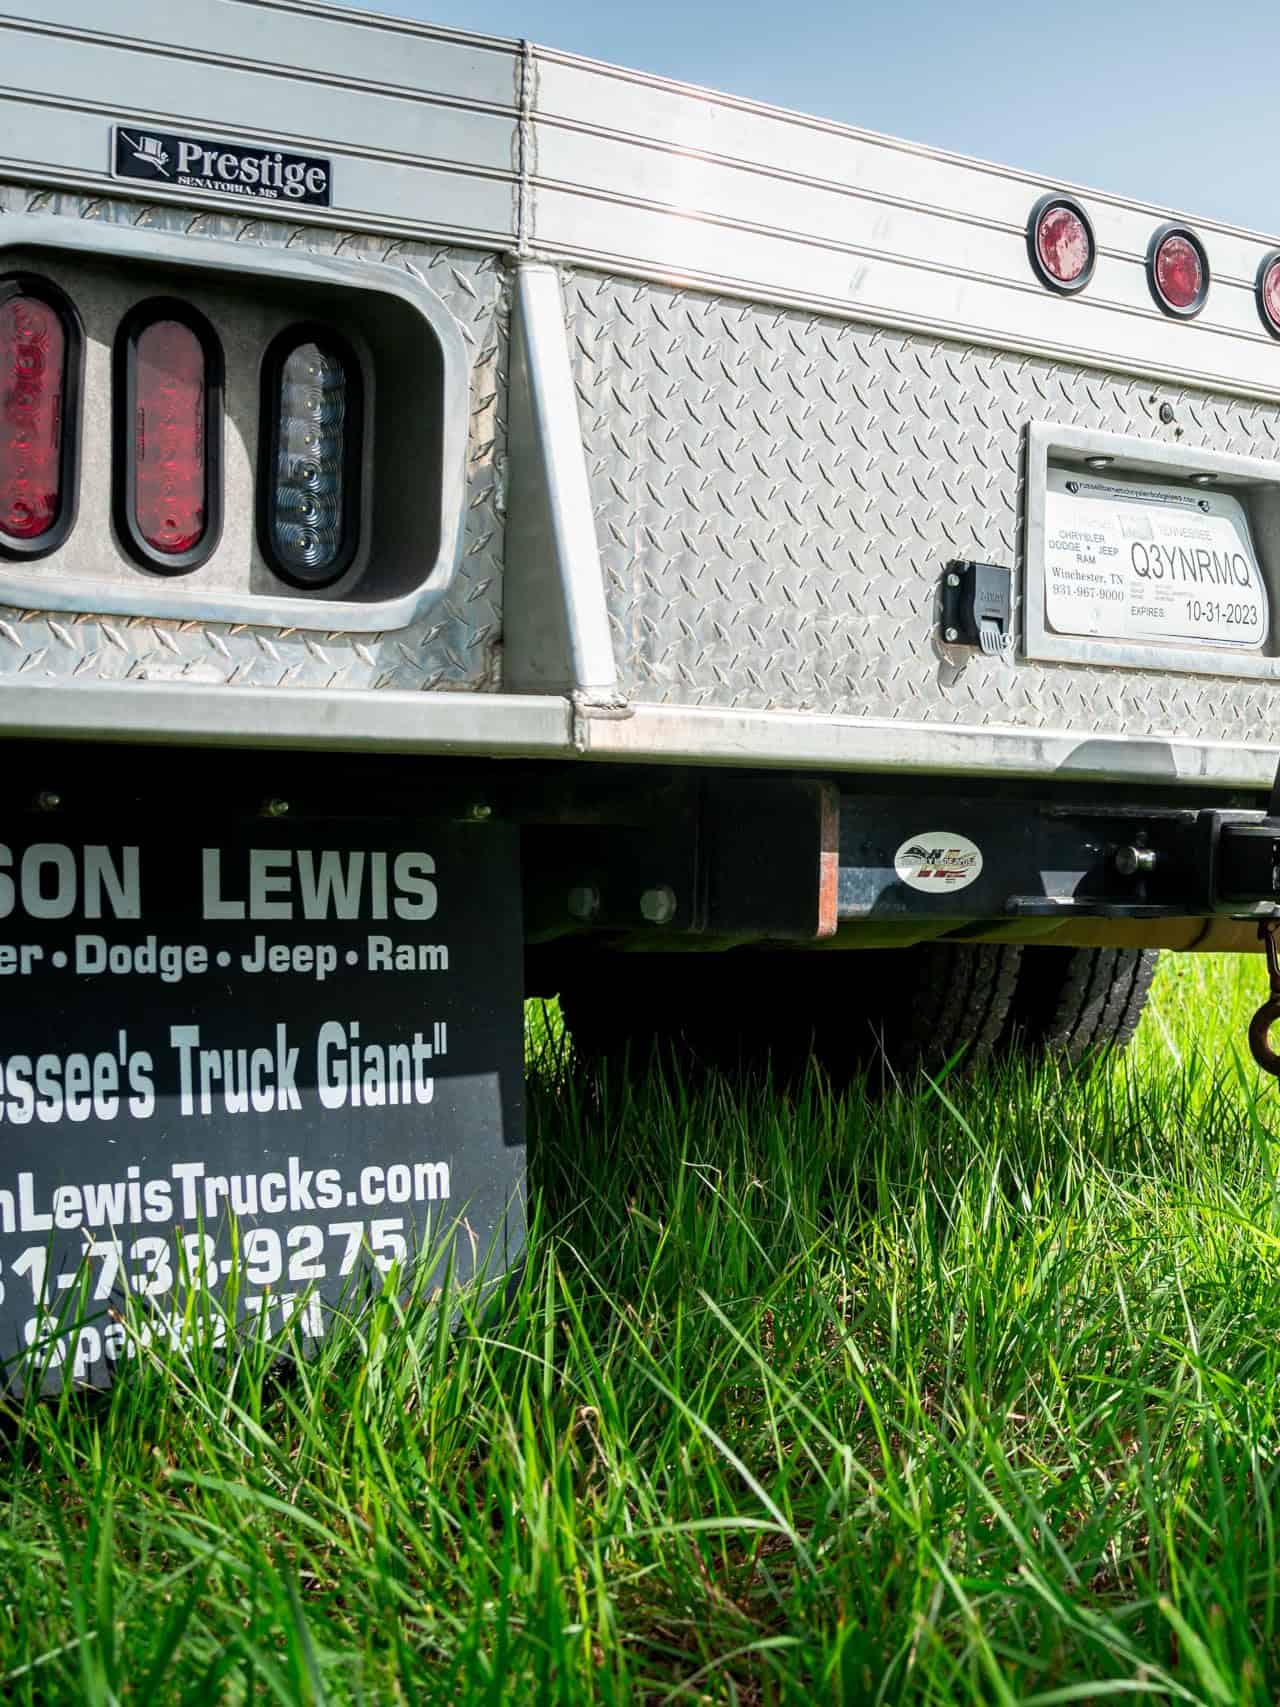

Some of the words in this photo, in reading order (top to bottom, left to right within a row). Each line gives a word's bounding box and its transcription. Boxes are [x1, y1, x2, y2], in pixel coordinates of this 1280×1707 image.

[177, 141, 327, 197] Prestige
[259, 187, 278, 199] MS
[1048, 539, 1081, 552] DODGE
[1076, 553, 1096, 564] RAM
[1131, 541, 1252, 588] Q3YNRMQ
[1110, 573, 1124, 585] TN
[1186, 600, 1257, 625] 10-31-2023
[0, 843, 141, 919] ON
[202, 848, 438, 921] LEWIS
[75, 934, 208, 983] Dodge
[241, 935, 337, 981] Jeep
[367, 935, 449, 972] Ram
[0, 1029, 155, 1125] ssee's
[170, 1023, 302, 1116] Truck
[0, 1217, 408, 1305] 1-738-9275
